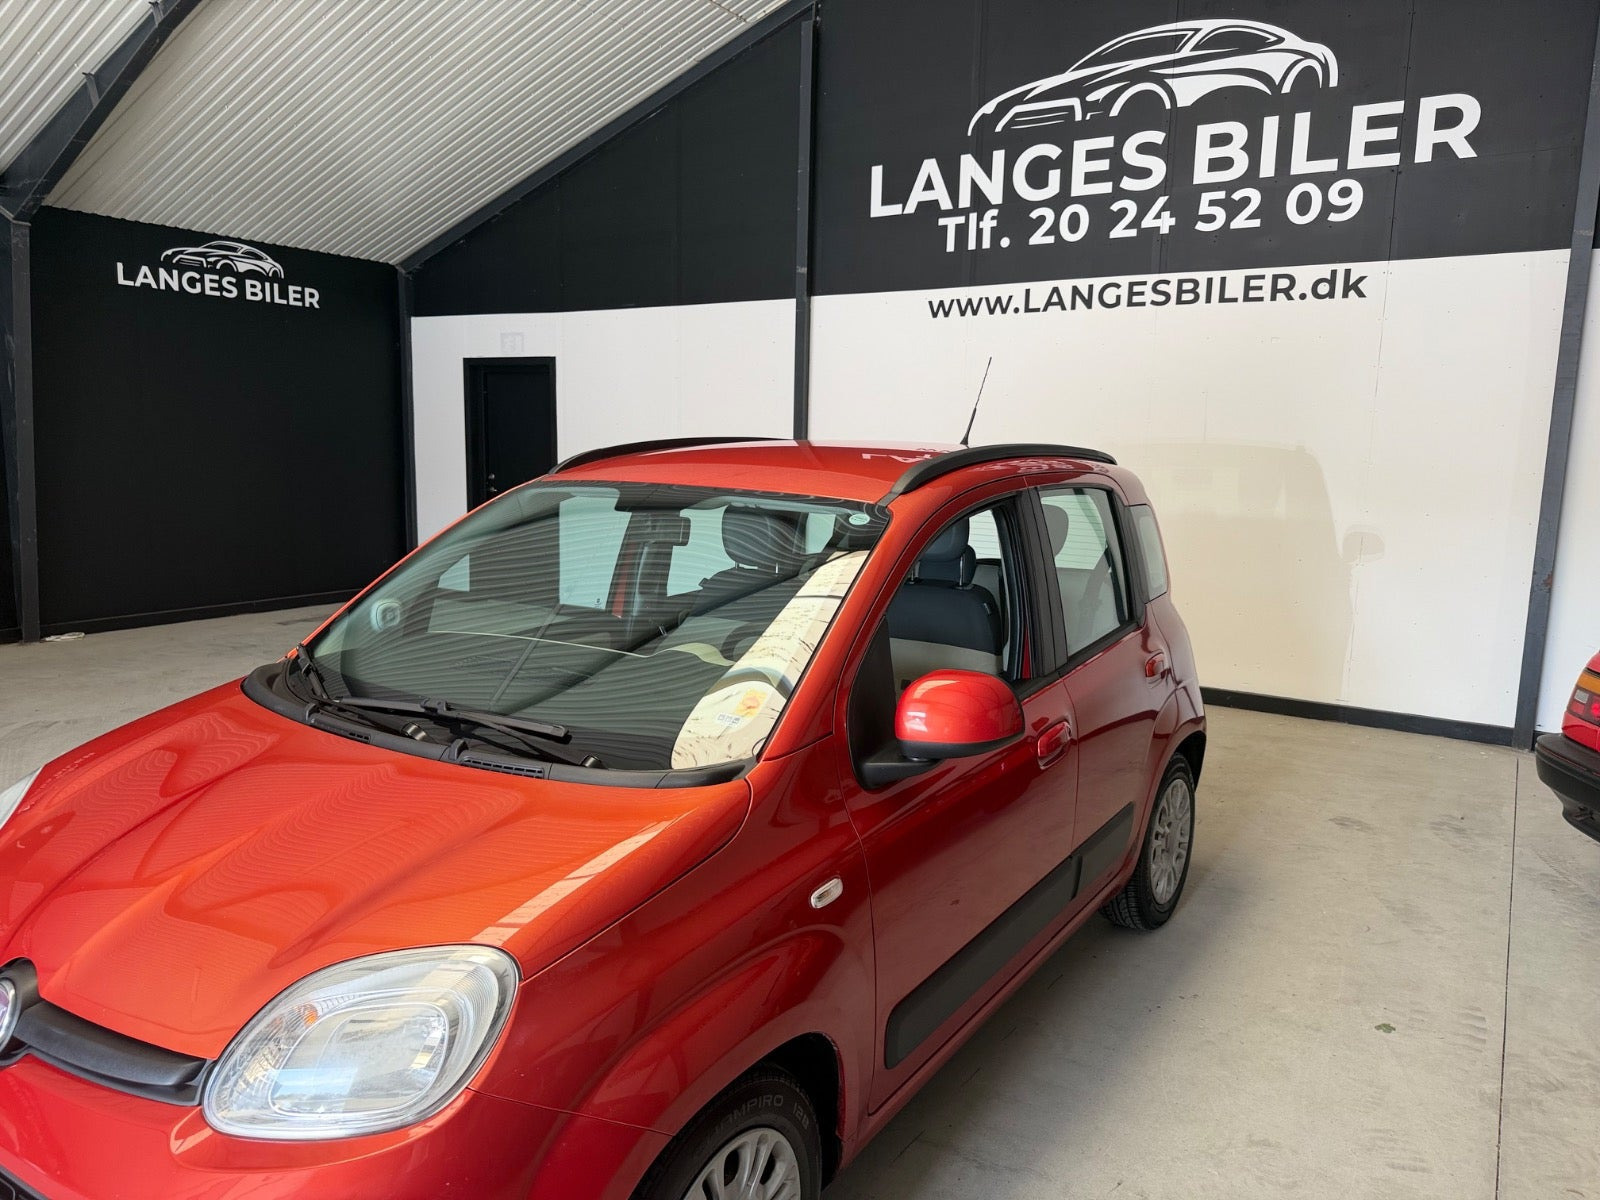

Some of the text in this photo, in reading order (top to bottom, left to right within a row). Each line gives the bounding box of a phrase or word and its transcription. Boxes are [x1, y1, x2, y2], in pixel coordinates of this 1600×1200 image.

[869, 93, 1482, 218] LANGES BILER
[937, 178, 1364, 253] Tlf. 20 24 52 09
[116, 261, 320, 309] LANGES BILER
[928, 268, 1368, 319] www.LANGESBILER.dk
